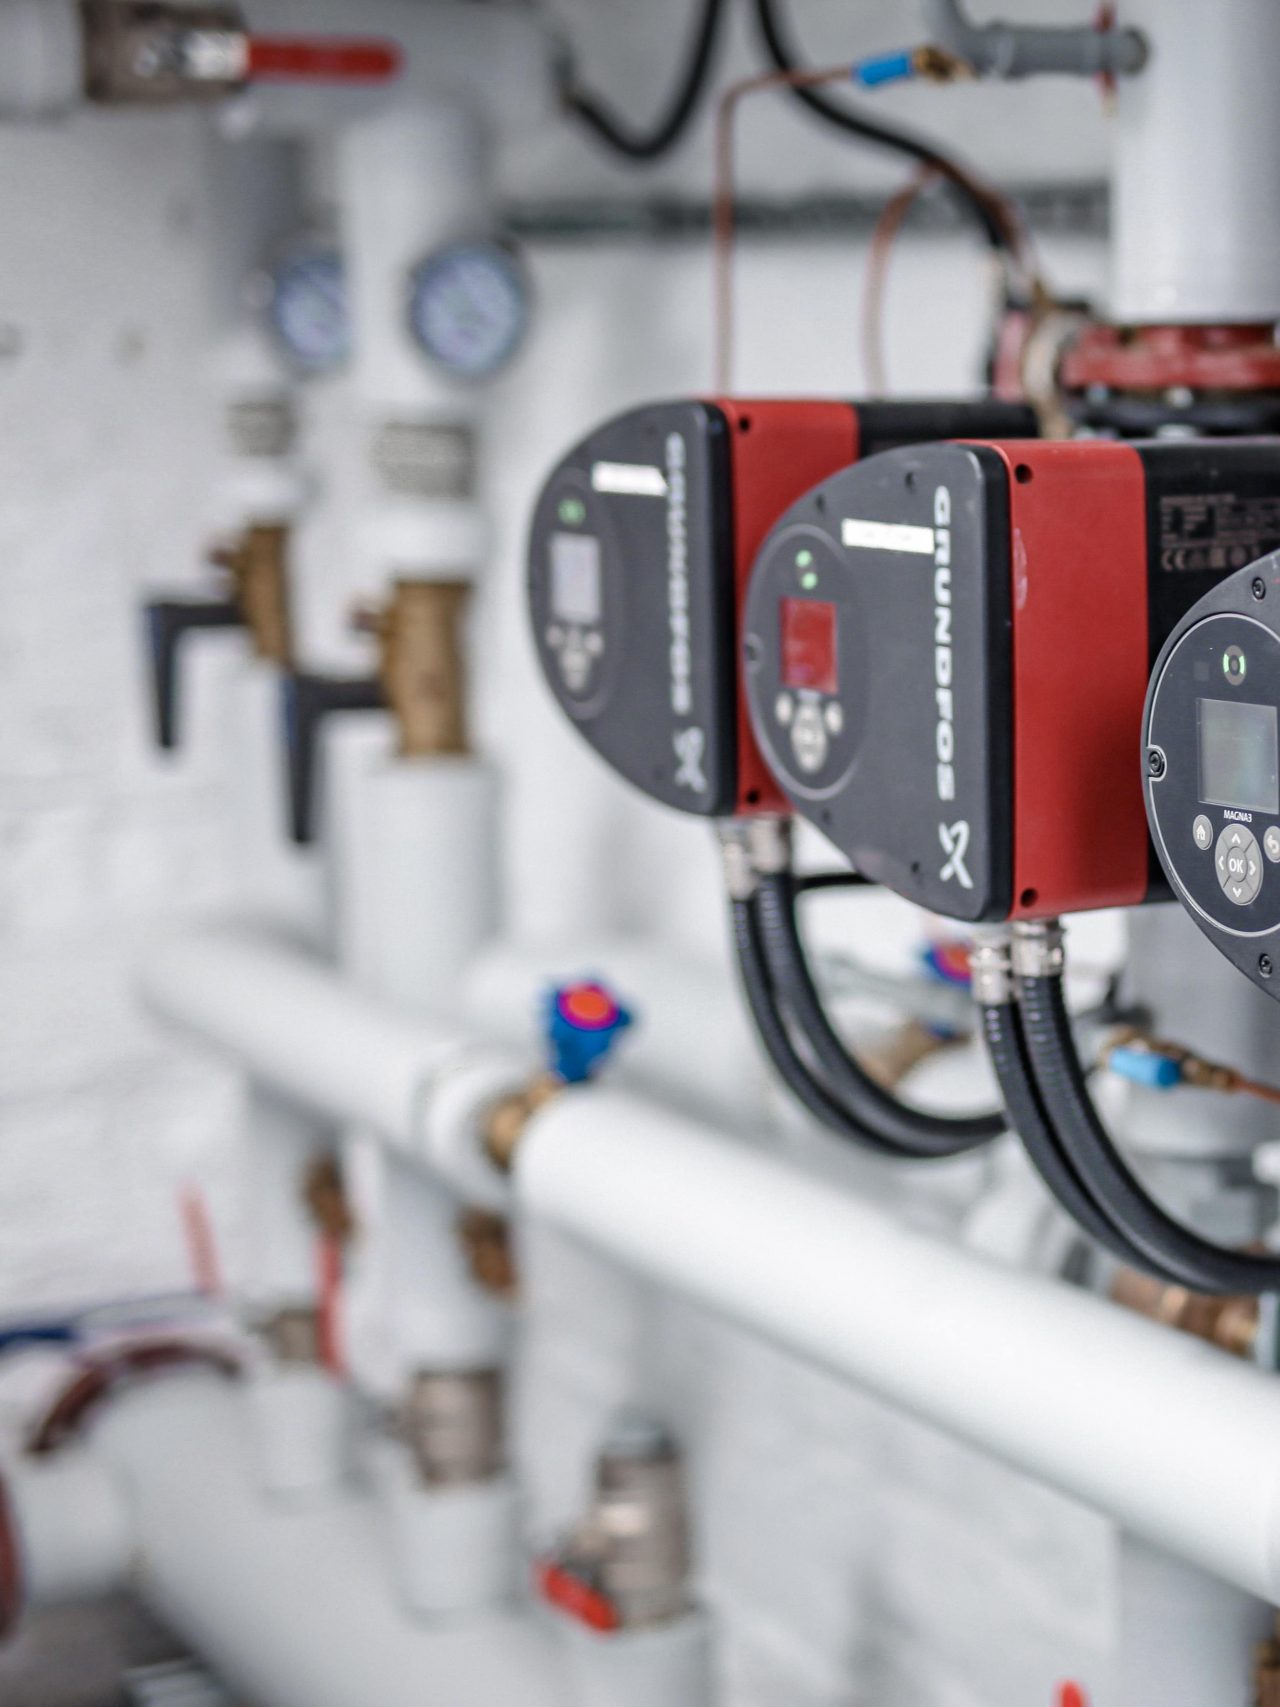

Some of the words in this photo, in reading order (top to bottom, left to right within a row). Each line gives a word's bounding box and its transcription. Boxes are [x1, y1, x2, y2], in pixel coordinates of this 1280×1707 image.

[934, 485, 955, 801] GRUNDFOS
[1223, 809, 1253, 823] MAGNA3
[1228, 858, 1244, 874] OK
